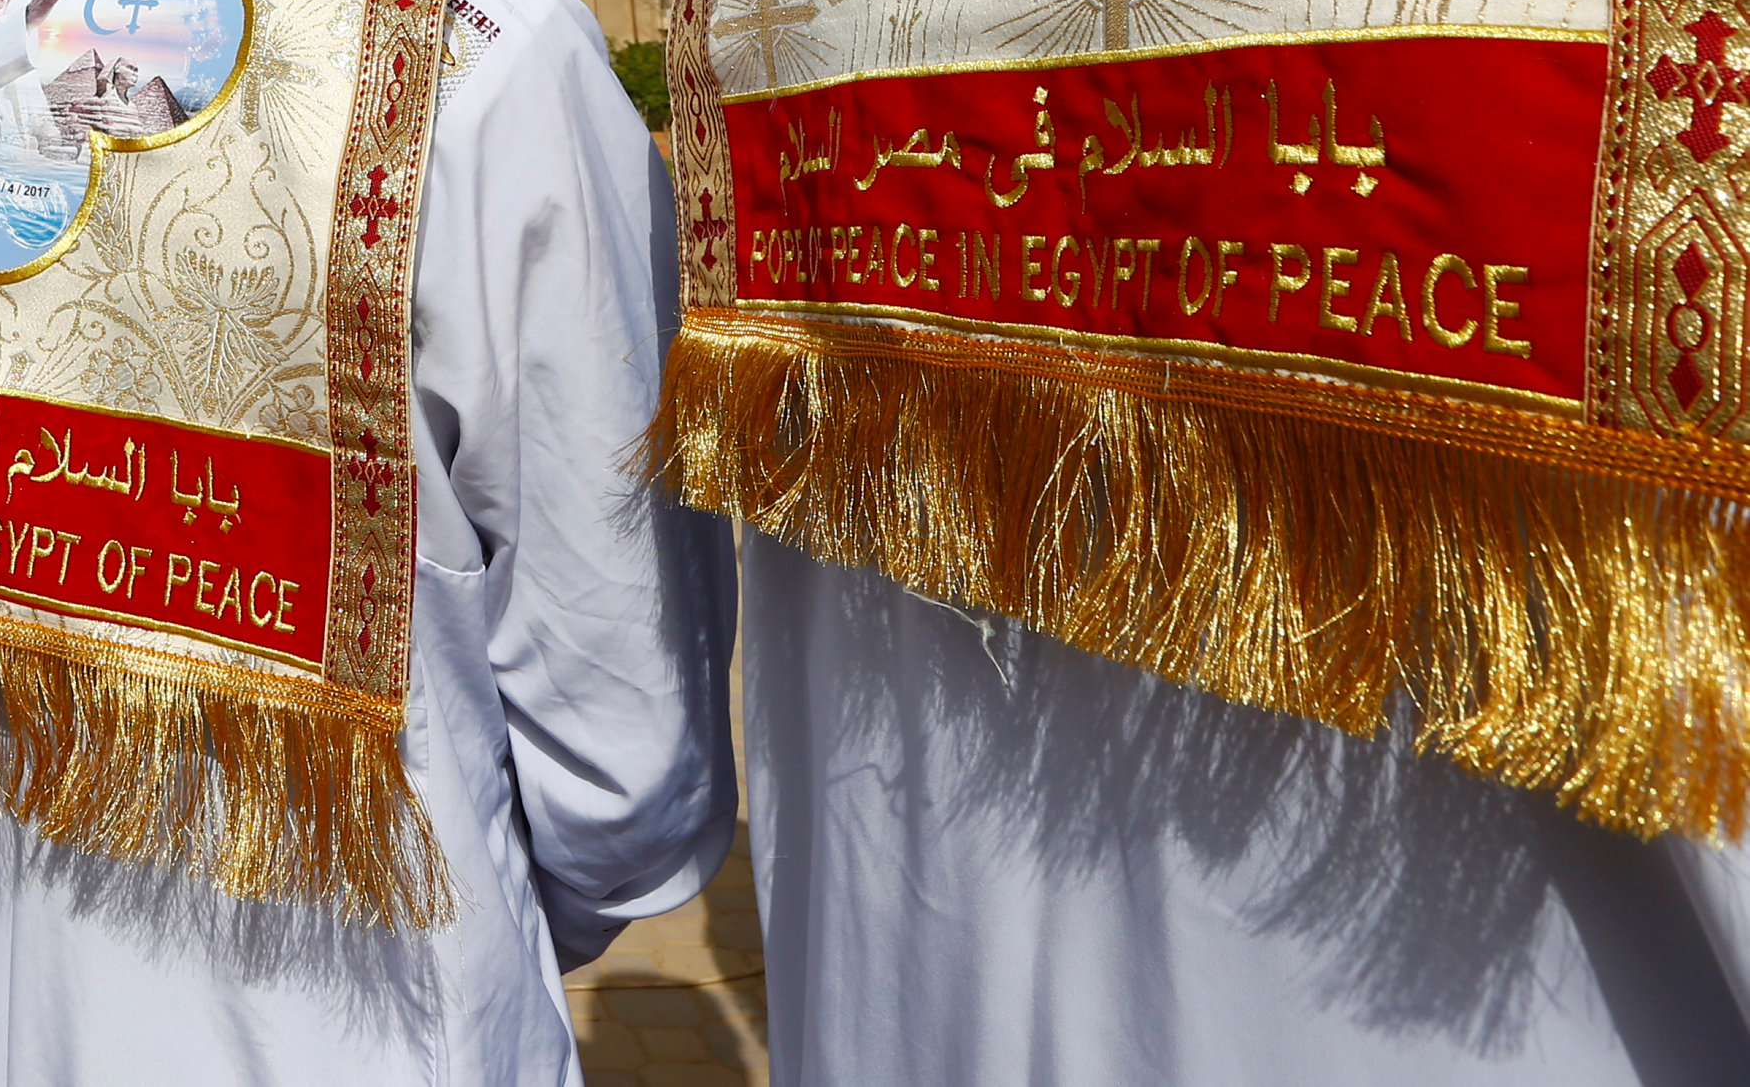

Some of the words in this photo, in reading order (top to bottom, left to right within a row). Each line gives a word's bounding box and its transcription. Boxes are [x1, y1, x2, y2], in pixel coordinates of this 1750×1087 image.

[853, 129, 961, 191] مصر
[1078, 78, 1233, 214] السلام
[1265, 77, 1386, 198] بابا
[7, 183, 14, 194] 4
[23, 185, 50, 198] 2017
[750, 229, 806, 284] POPE
[831, 223, 939, 291] PEACE
[956, 232, 1000, 299] IN
[1021, 235, 1162, 310] EGYPT
[1178, 236, 1243, 316] OF
[1266, 242, 1533, 360] PEACE
[6, 427, 147, 504] السلام
[170, 451, 241, 534] بابا
[96, 539, 153, 600] OF
[163, 553, 301, 635] PEACE
